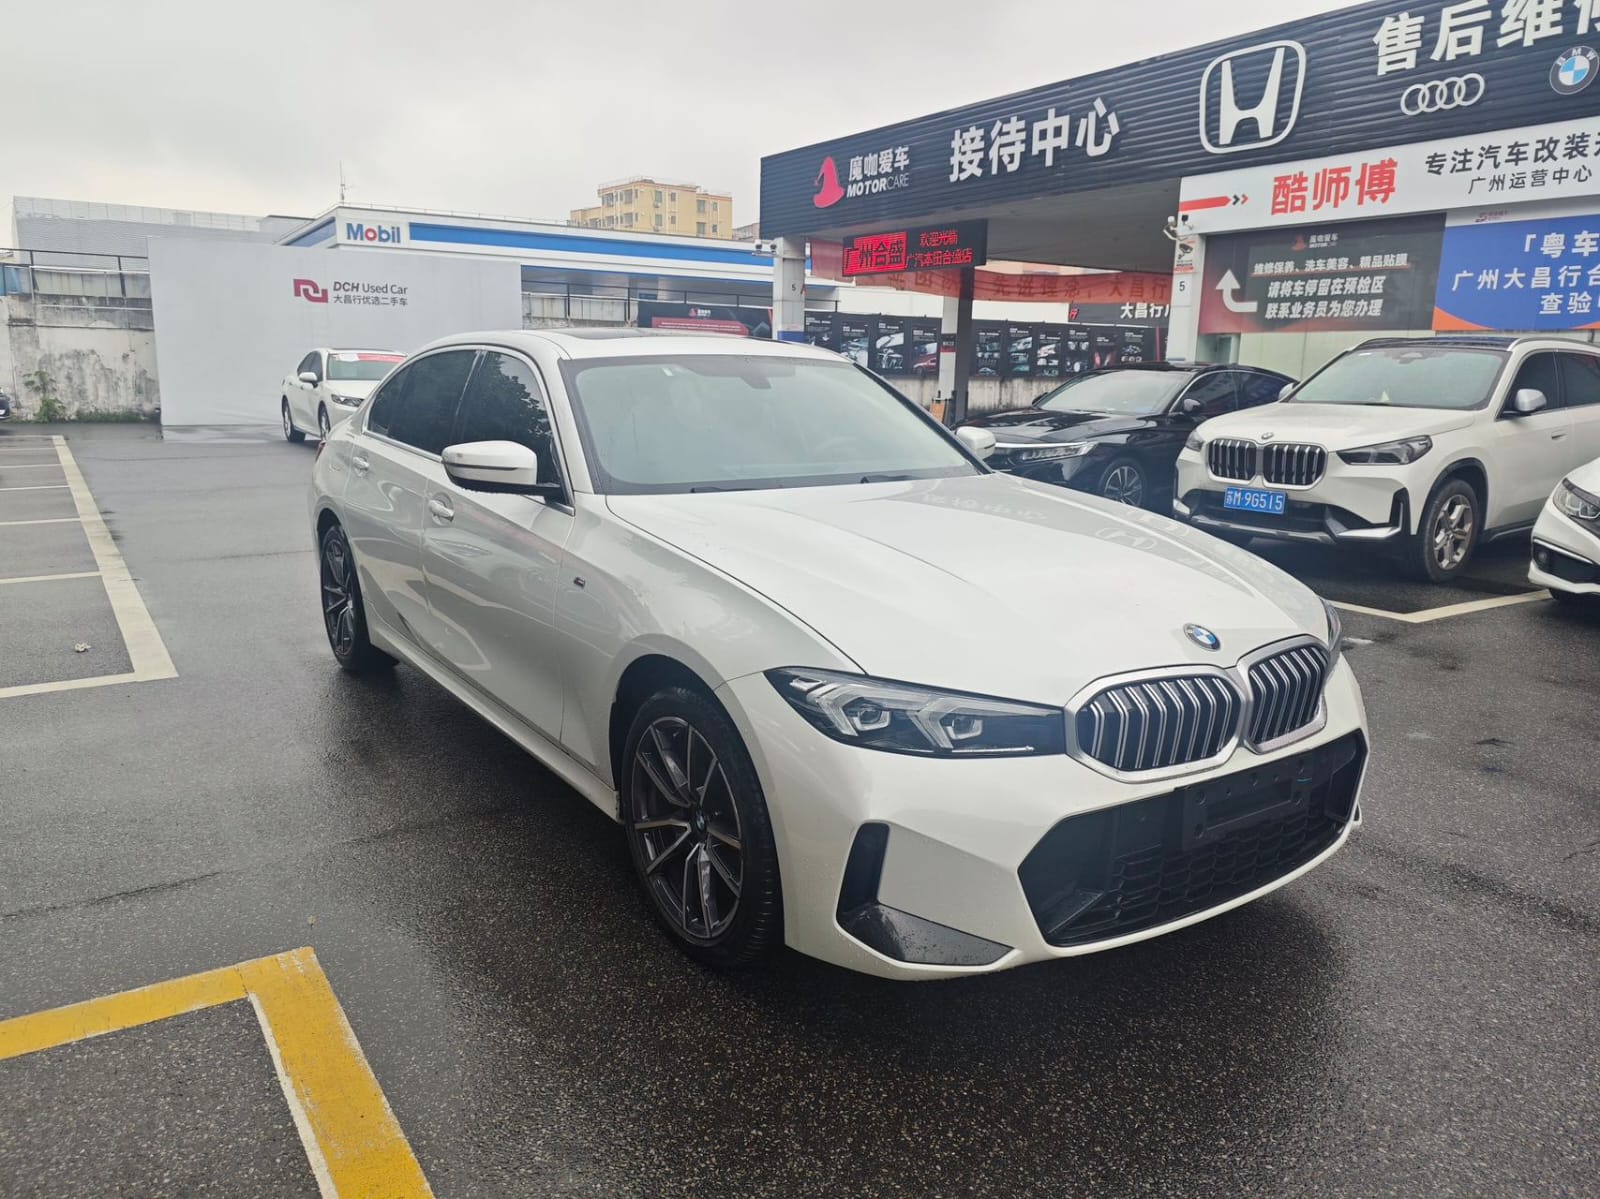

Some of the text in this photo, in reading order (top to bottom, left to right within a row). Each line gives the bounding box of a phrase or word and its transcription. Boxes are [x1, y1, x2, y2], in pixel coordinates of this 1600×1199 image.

[949, 97, 1120, 183] 接待中心
[849, 146, 910, 181] 魔咖爱车
[1425, 132, 1600, 176] 专注汽车改装
[847, 173, 910, 198] MOTORCARE
[1270, 157, 1398, 216] 酷师傅
[1468, 164, 1592, 194] 广州运营中心
[346, 222, 401, 243] Mobil
[844, 240, 903, 269] 广州合盛
[333, 281, 408, 295] DCH Used Car
[1179, 280, 1186, 292] 5
[1267, 275, 1386, 298] 请将车停留在预检区
[333, 294, 408, 306] 大昌行优选二手车
[1120, 302, 1170, 319] 大昌行
[1265, 299, 1383, 319] 联系业务员为您办理
[1539, 291, 1600, 315] 查验
